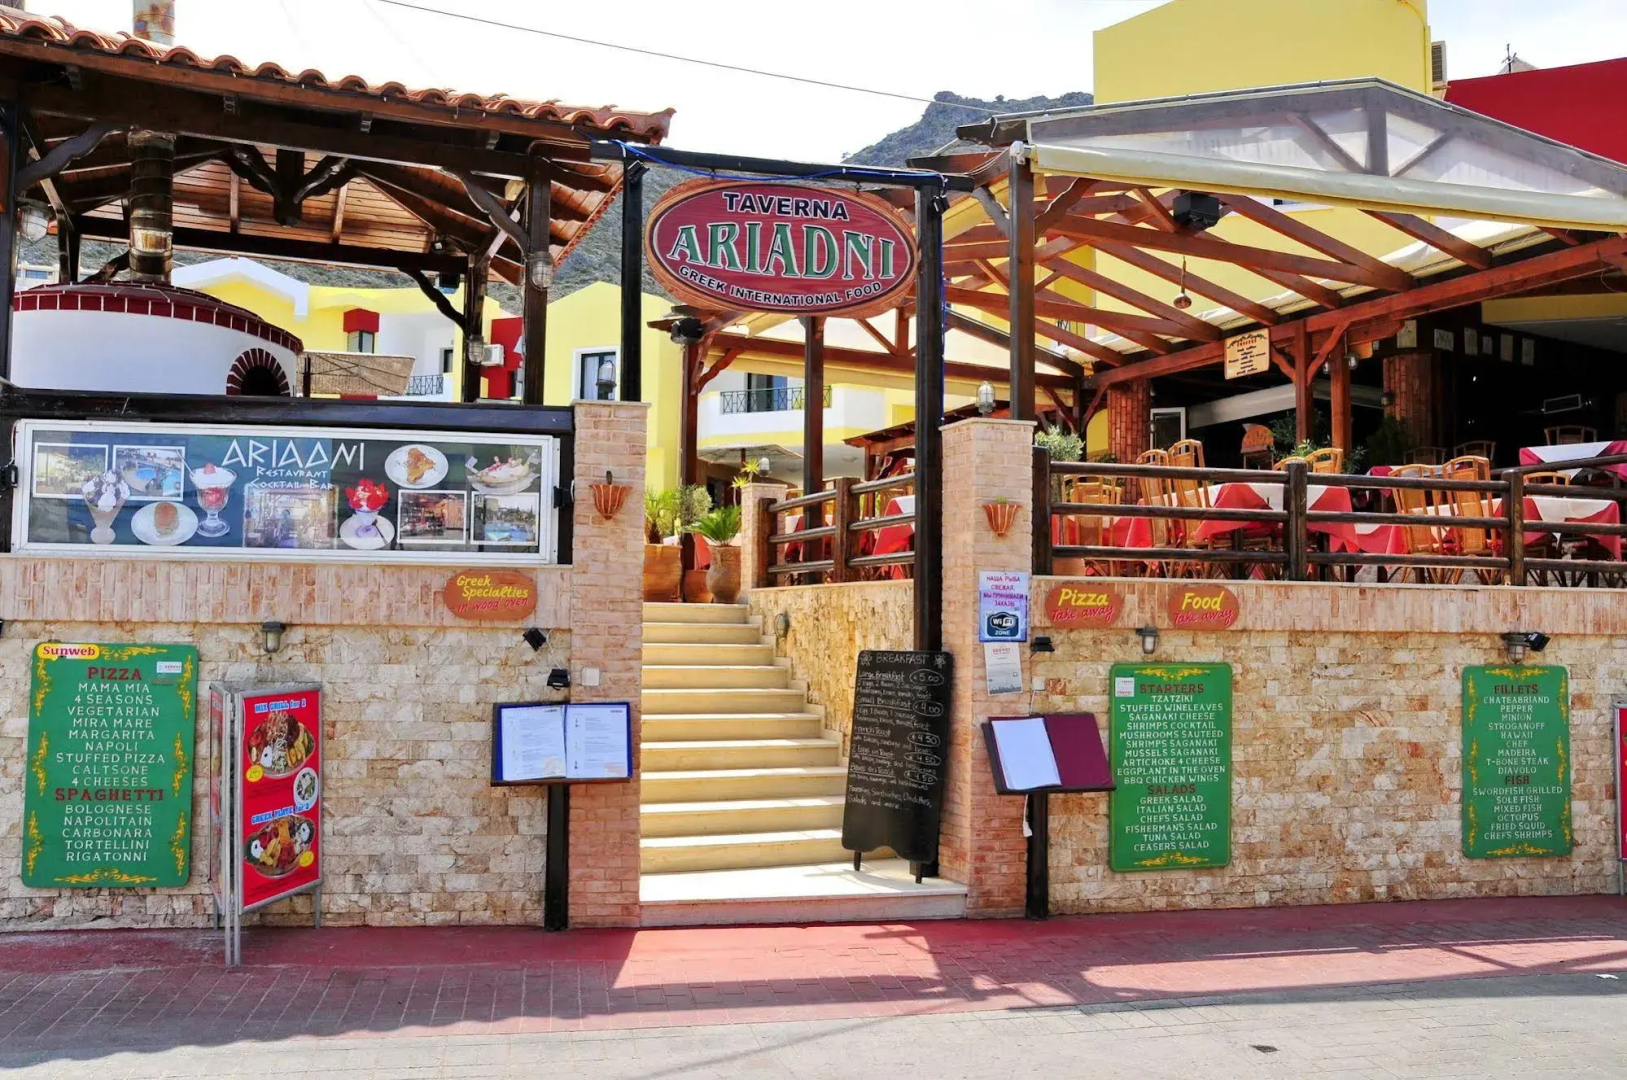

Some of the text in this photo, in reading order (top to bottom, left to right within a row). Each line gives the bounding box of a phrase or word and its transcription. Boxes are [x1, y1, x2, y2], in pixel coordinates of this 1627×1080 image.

[722, 192, 850, 221] TAVERNA
[667, 221, 896, 280] ARIADNI
[679, 265, 882, 306] GREEK INTERNATIONAL FOOD
[457, 575, 492, 586] Greek
[462, 586, 528, 601] Specialties
[1058, 589, 1109, 606] Pizza
[473, 600, 499, 611] wood
[505, 598, 529, 608] oven
[1182, 591, 1225, 611] Food
[1052, 606, 1114, 623] Take away
[1175, 609, 1234, 627] Take away
[42, 645, 96, 657] Sunweb
[876, 652, 930, 664] BREAKFAST
[88, 666, 143, 681] PIZZA
[78, 682, 150, 693] MAMA MIA
[1140, 684, 1204, 694] STARTERS
[1494, 684, 1539, 694] FILLETS
[74, 694, 154, 705] 4 SEASONS
[67, 706, 159, 716] VEGETARIAN
[1164, 704, 1223, 712] WINELEAVES
[73, 718, 152, 728] MIRA MARE
[68, 729, 155, 740] MARGARITA
[1120, 731, 1179, 739] MUSHROOMS
[85, 741, 139, 751] NAPOLI
[1126, 740, 1167, 748] SHRIMPS
[56, 753, 165, 763] STUFFED PIZZA
[1125, 749, 1167, 757] MUSSELS
[1123, 758, 1176, 766] ARTICHOKE
[72, 765, 148, 775] CALTSONE
[1117, 767, 1167, 775] EGGPLANT
[72, 777, 148, 787] 4 CHEESES
[1189, 774, 1219, 783] WINGS
[1505, 775, 1531, 785] FISH
[1148, 784, 1196, 794] SALADS
[55, 789, 164, 802] SPAGHETTI
[65, 805, 152, 814] BOLOGNESE
[64, 816, 152, 826] NAPOLITAIN
[62, 828, 153, 838] CARBONARA
[65, 840, 150, 850] TORTELLINI
[66, 852, 147, 861] RIGATONNI
